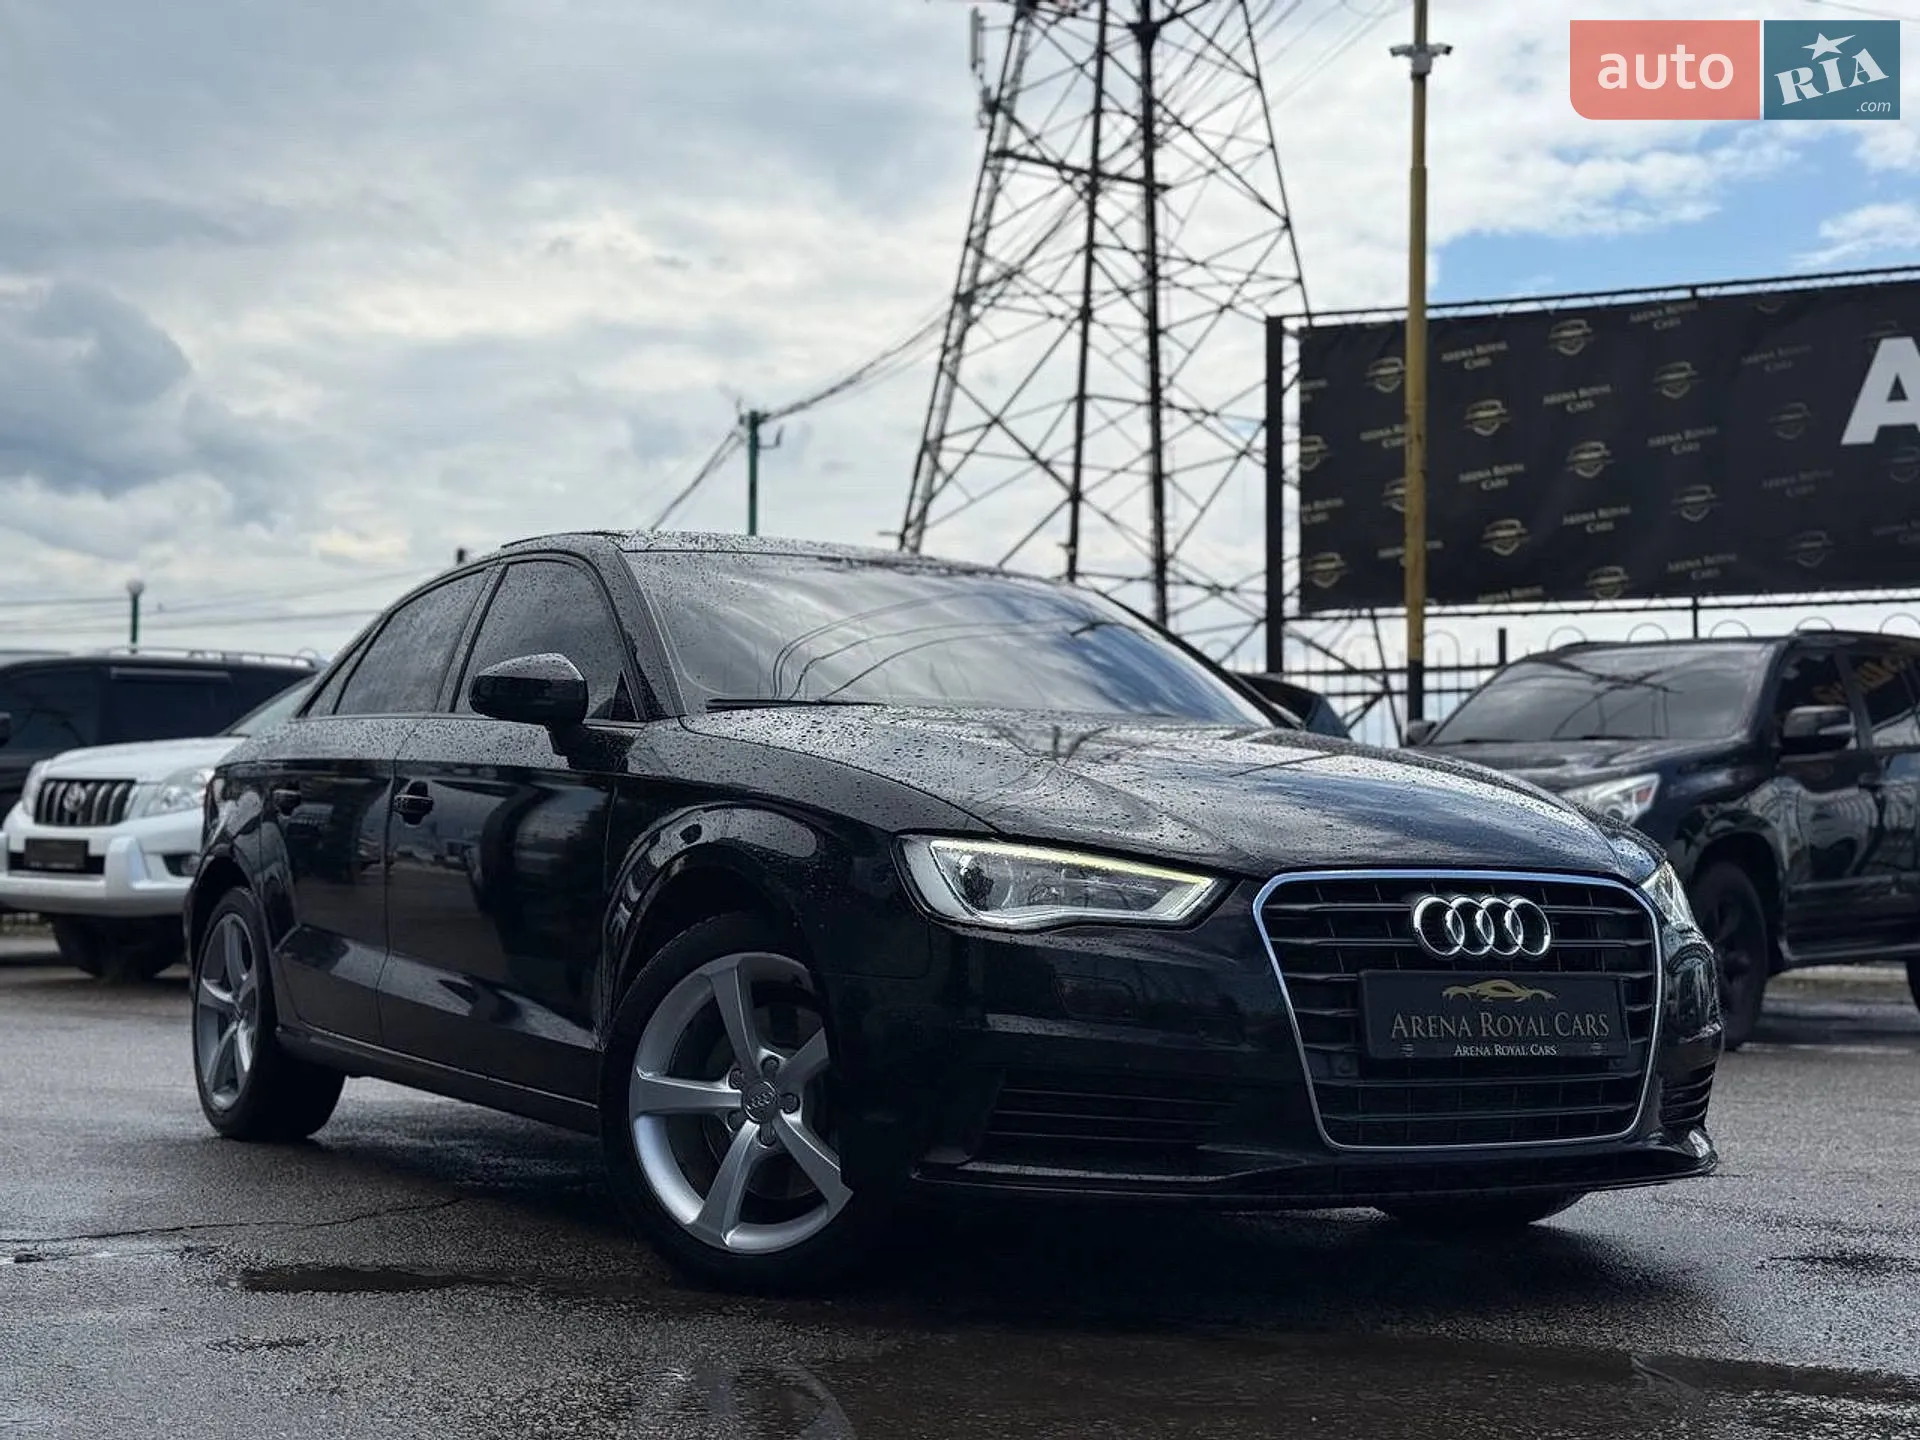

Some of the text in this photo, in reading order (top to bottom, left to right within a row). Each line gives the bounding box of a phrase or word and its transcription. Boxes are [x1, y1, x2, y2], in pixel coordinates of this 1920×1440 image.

[1392, 1012, 1610, 1039] ARENA ROYAL CARS
[1454, 1043, 1557, 1056] ARENA ROYAL CARS
